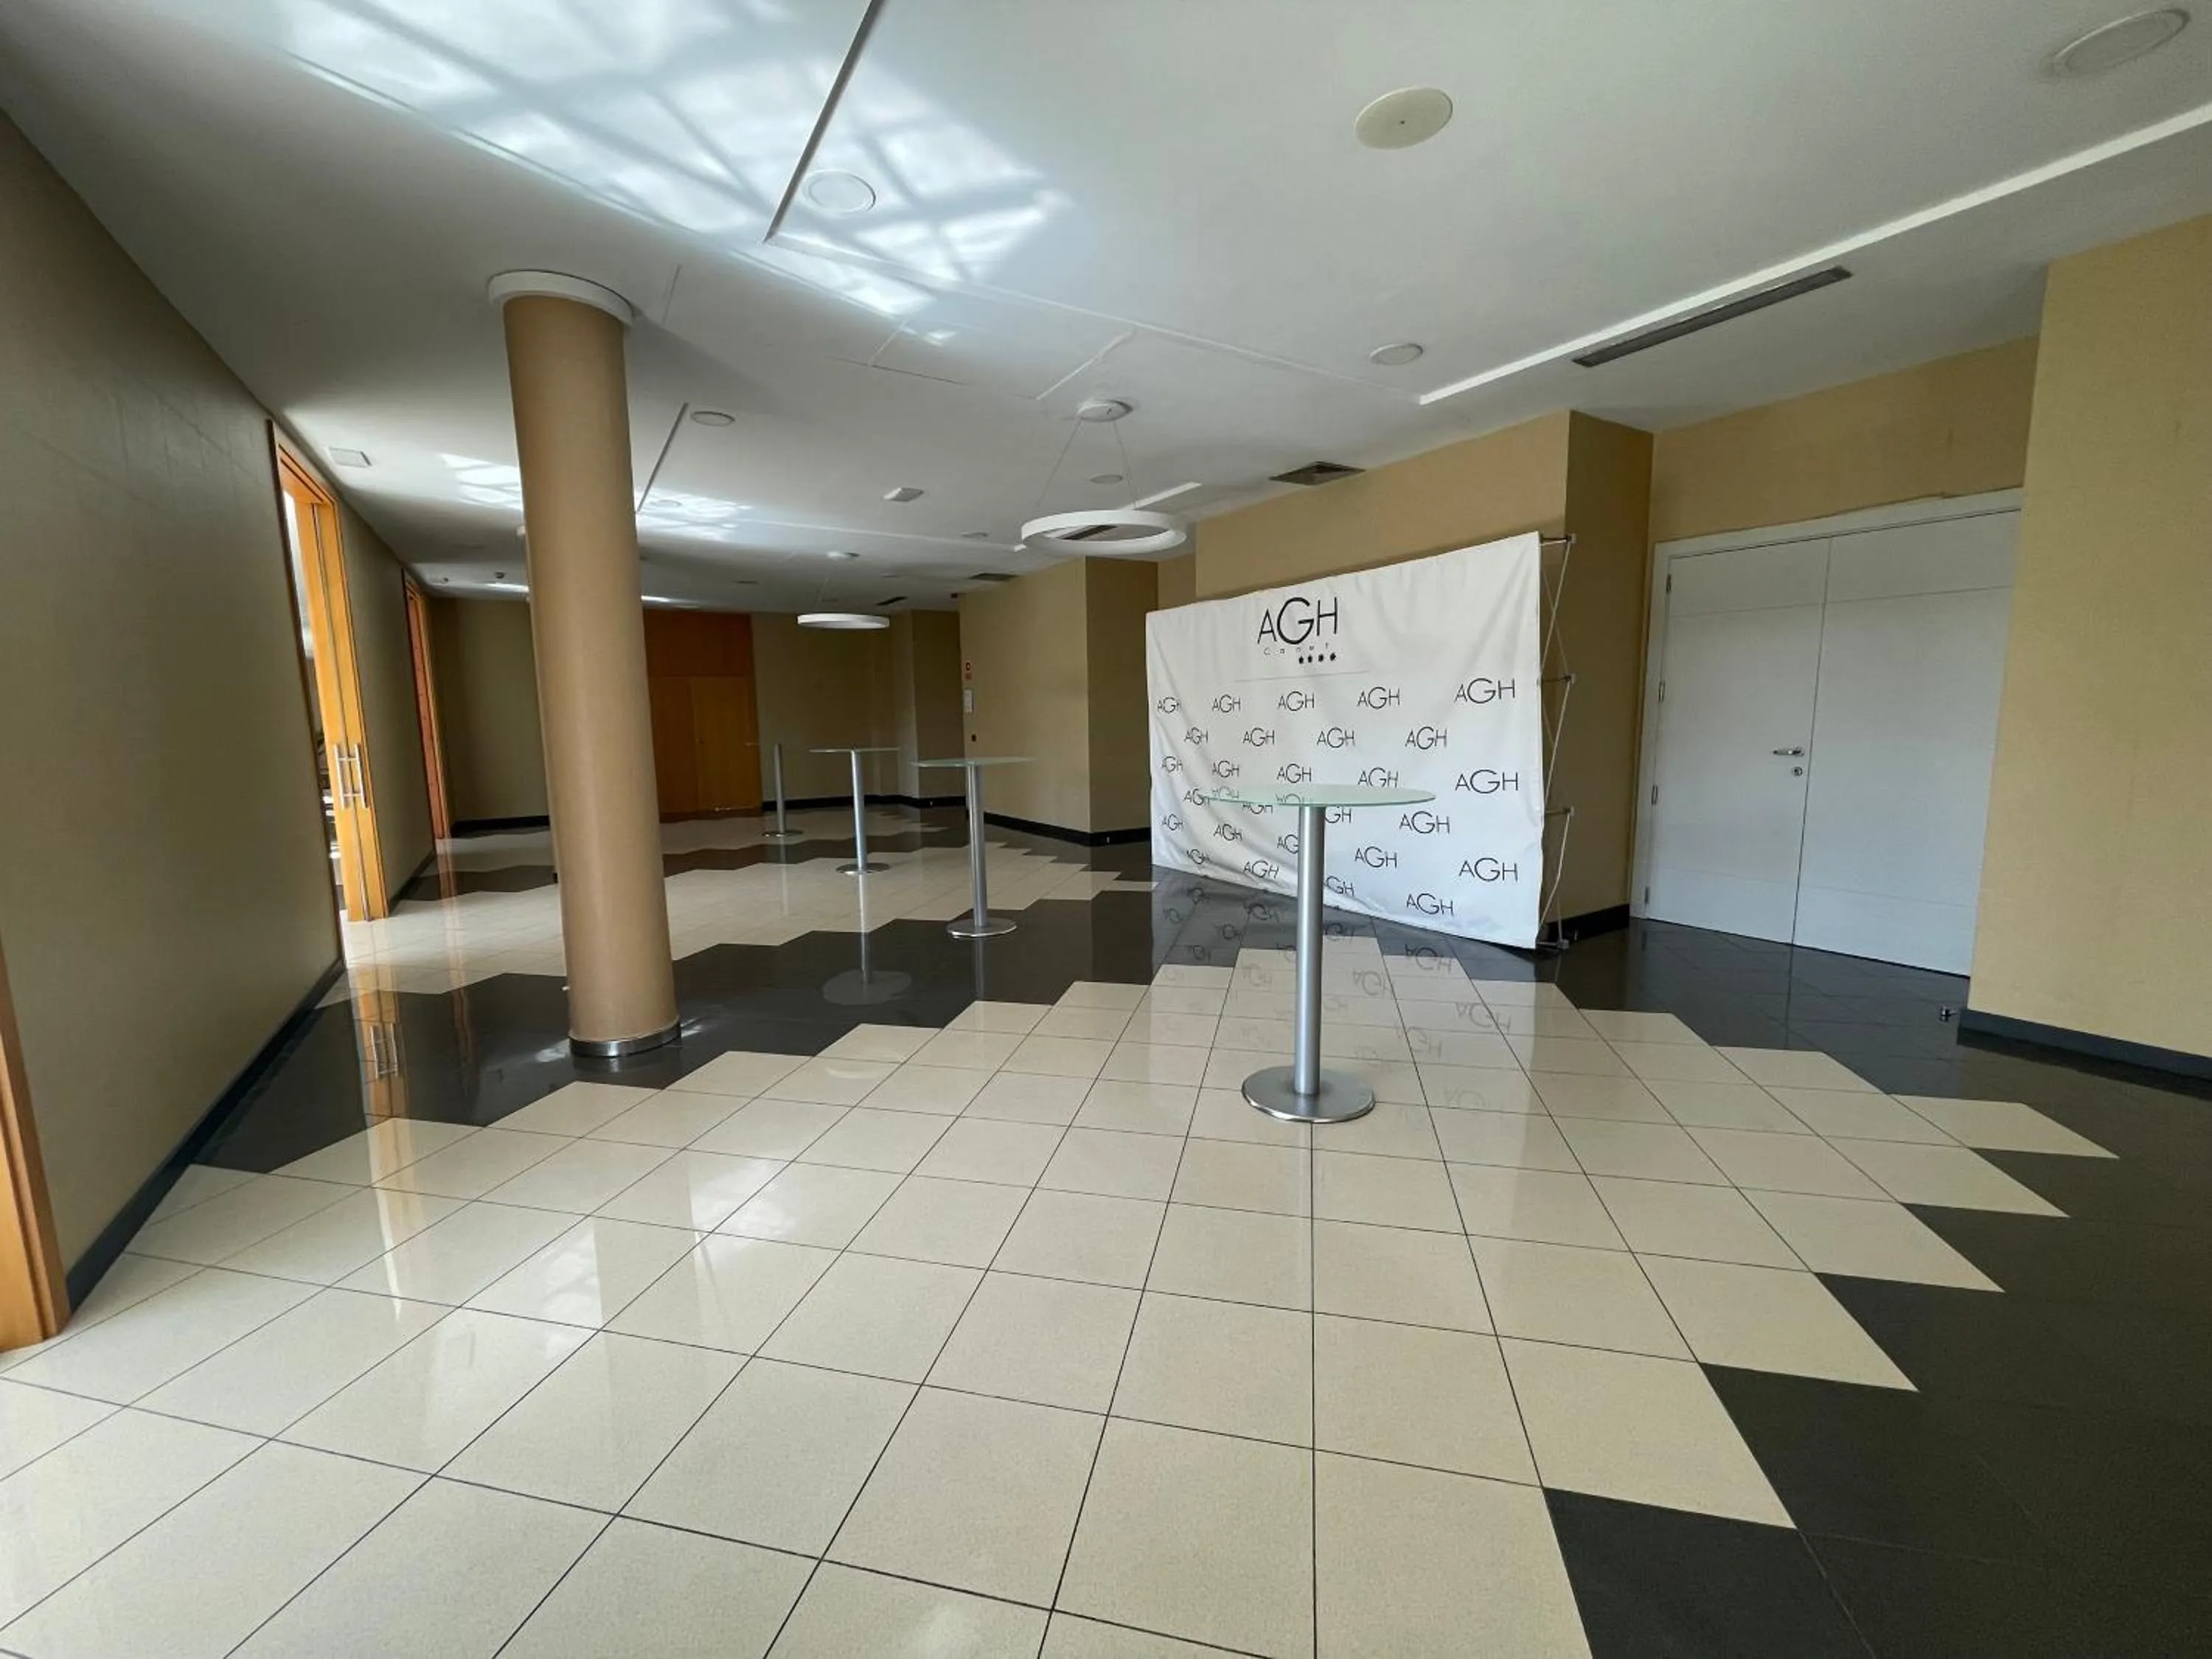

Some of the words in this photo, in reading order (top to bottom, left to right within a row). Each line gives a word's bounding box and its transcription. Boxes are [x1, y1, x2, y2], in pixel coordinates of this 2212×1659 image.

[1256, 597, 1338, 645] AGH
[1277, 691, 1315, 712] AGH
[1357, 686, 1400, 709] AGH
[1455, 678, 1516, 704] AGH
[1211, 694, 1241, 713] AGH
[1183, 726, 1208, 745] AGH
[1242, 727, 1275, 747] AGH
[1316, 727, 1355, 748] AGH
[1405, 726, 1447, 750] AGH
[1211, 760, 1239, 778] AGH
[1276, 763, 1312, 784] AGH
[1357, 767, 1399, 788] AGH
[1455, 769, 1519, 794] AGH
[1325, 805, 1352, 824] GH
[1399, 810, 1450, 834] AGH
[1214, 824, 1243, 841] AGH
[1277, 834, 1298, 854] AG
[1354, 846, 1398, 868] AGH
[1243, 860, 1279, 879] AGH
[1458, 858, 1518, 882] AGH
[1324, 875, 1355, 897] GH
[1406, 893, 1454, 917] AGH
